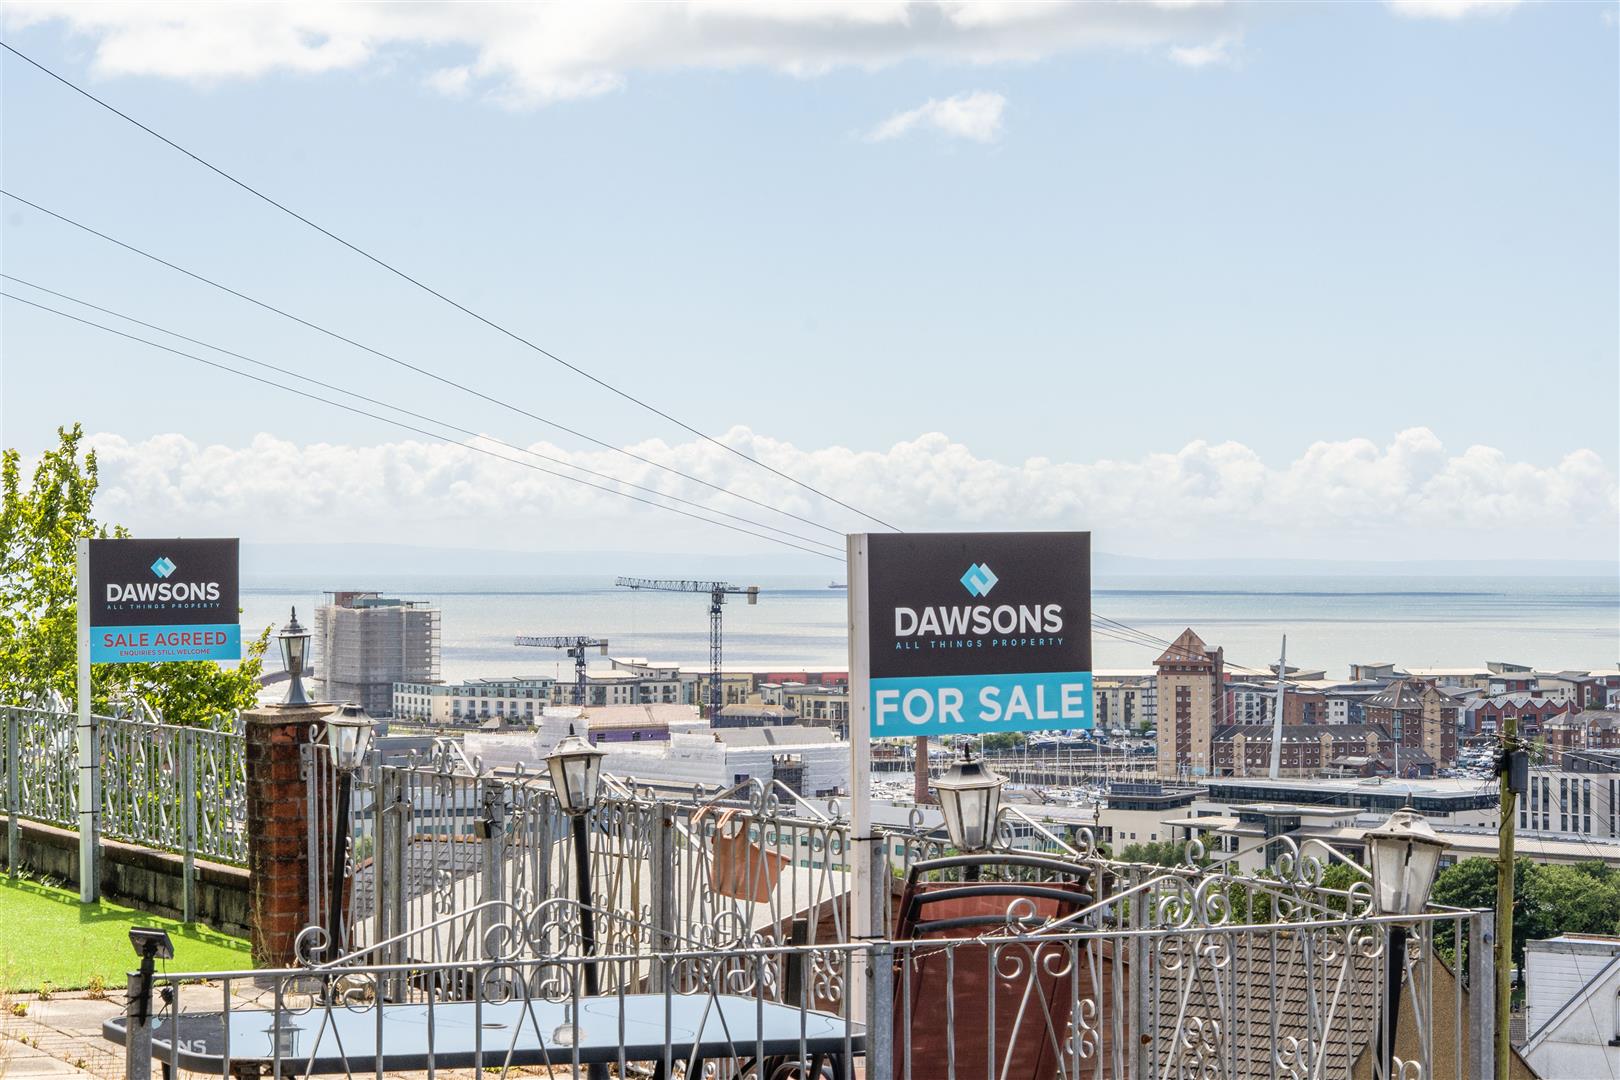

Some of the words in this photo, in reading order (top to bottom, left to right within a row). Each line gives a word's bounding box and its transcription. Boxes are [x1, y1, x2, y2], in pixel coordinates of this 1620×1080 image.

[106, 582, 220, 602] DAWSONS
[895, 603, 1063, 637] DAWSONS
[103, 633, 149, 648] SALE
[154, 631, 227, 647] AGREED
[895, 641, 920, 650] ALL
[930, 639, 982, 648] THINGS
[992, 637, 1064, 647] PROPERTY
[875, 688, 965, 726] FOR
[978, 683, 1084, 722] SALE
